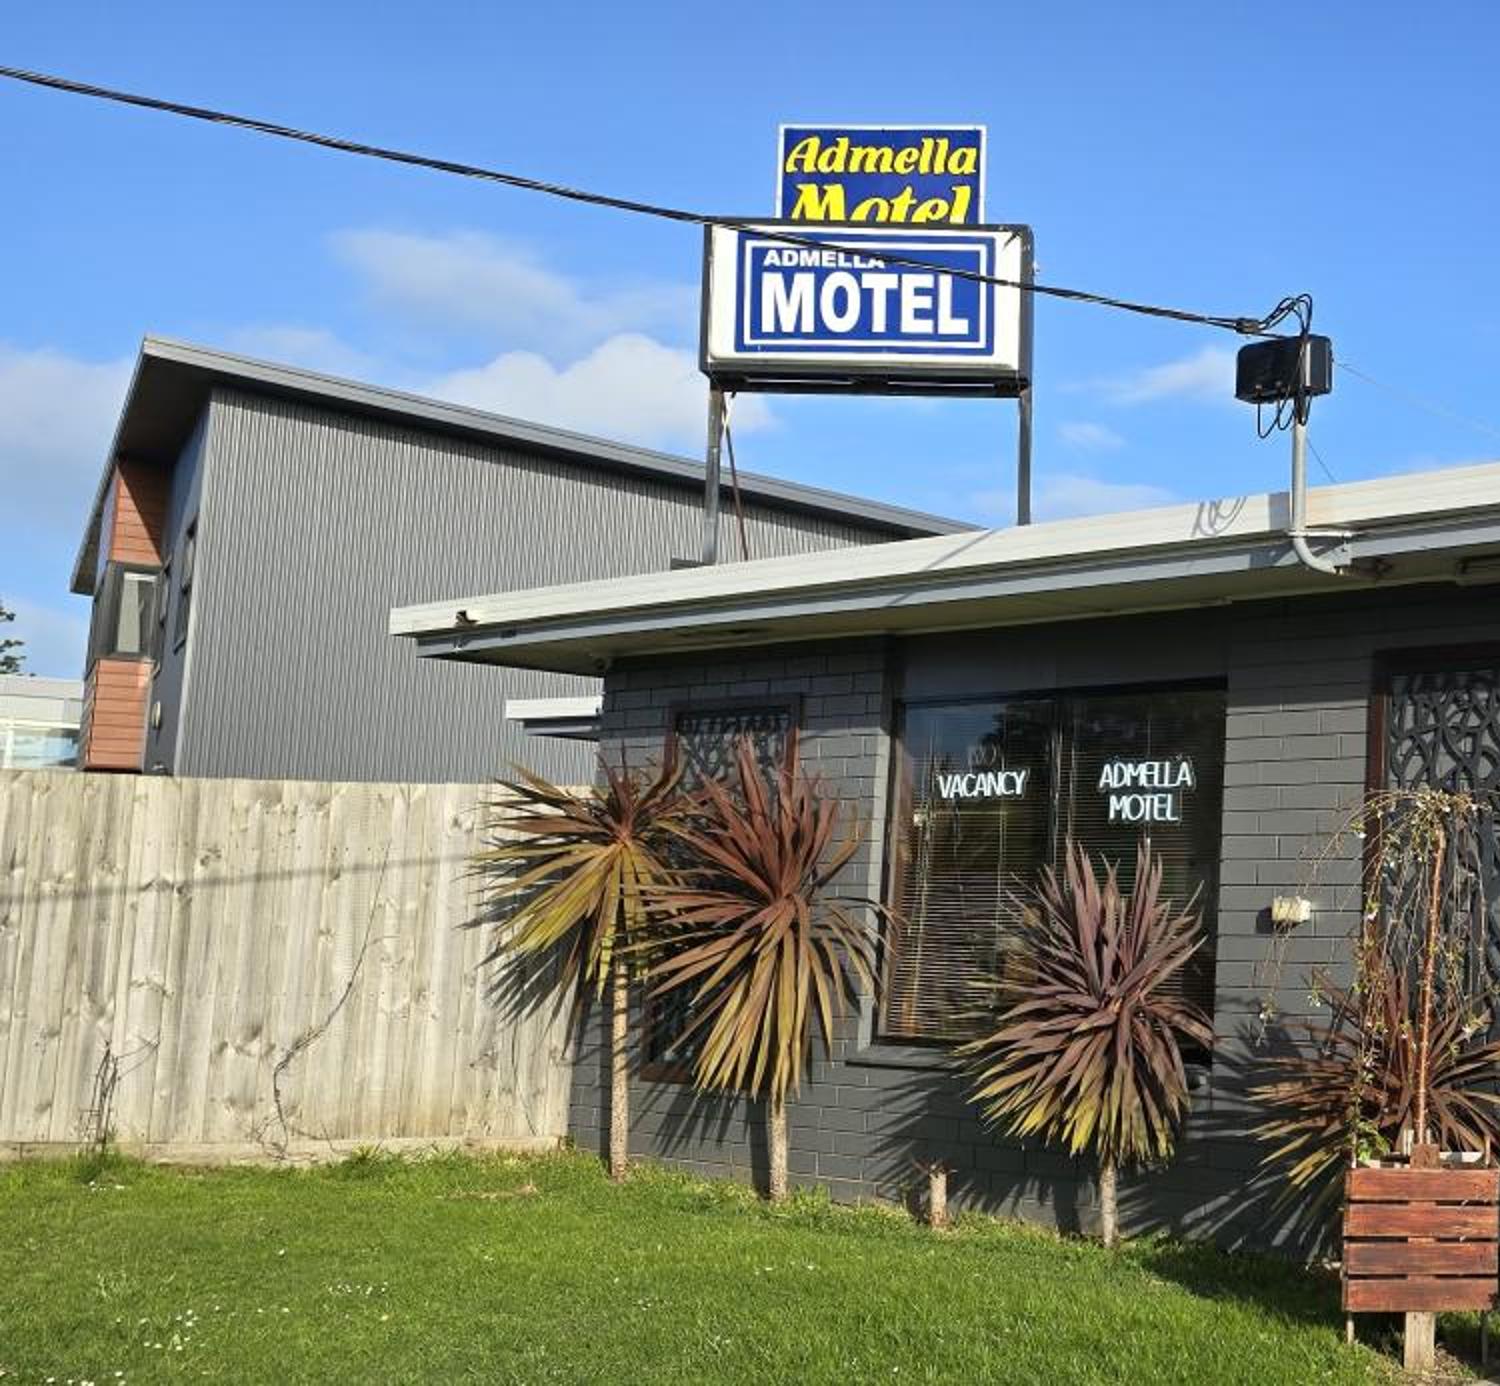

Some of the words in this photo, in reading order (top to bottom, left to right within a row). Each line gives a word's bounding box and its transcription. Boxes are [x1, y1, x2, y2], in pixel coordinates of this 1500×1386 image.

[787, 136, 976, 175] Admella
[792, 184, 971, 223] Motel
[761, 272, 969, 335] MOTEL
[939, 770, 1026, 798] VACANCY
[1099, 761, 1191, 788] ADMELLA
[1109, 793, 1179, 820] MOTEL
